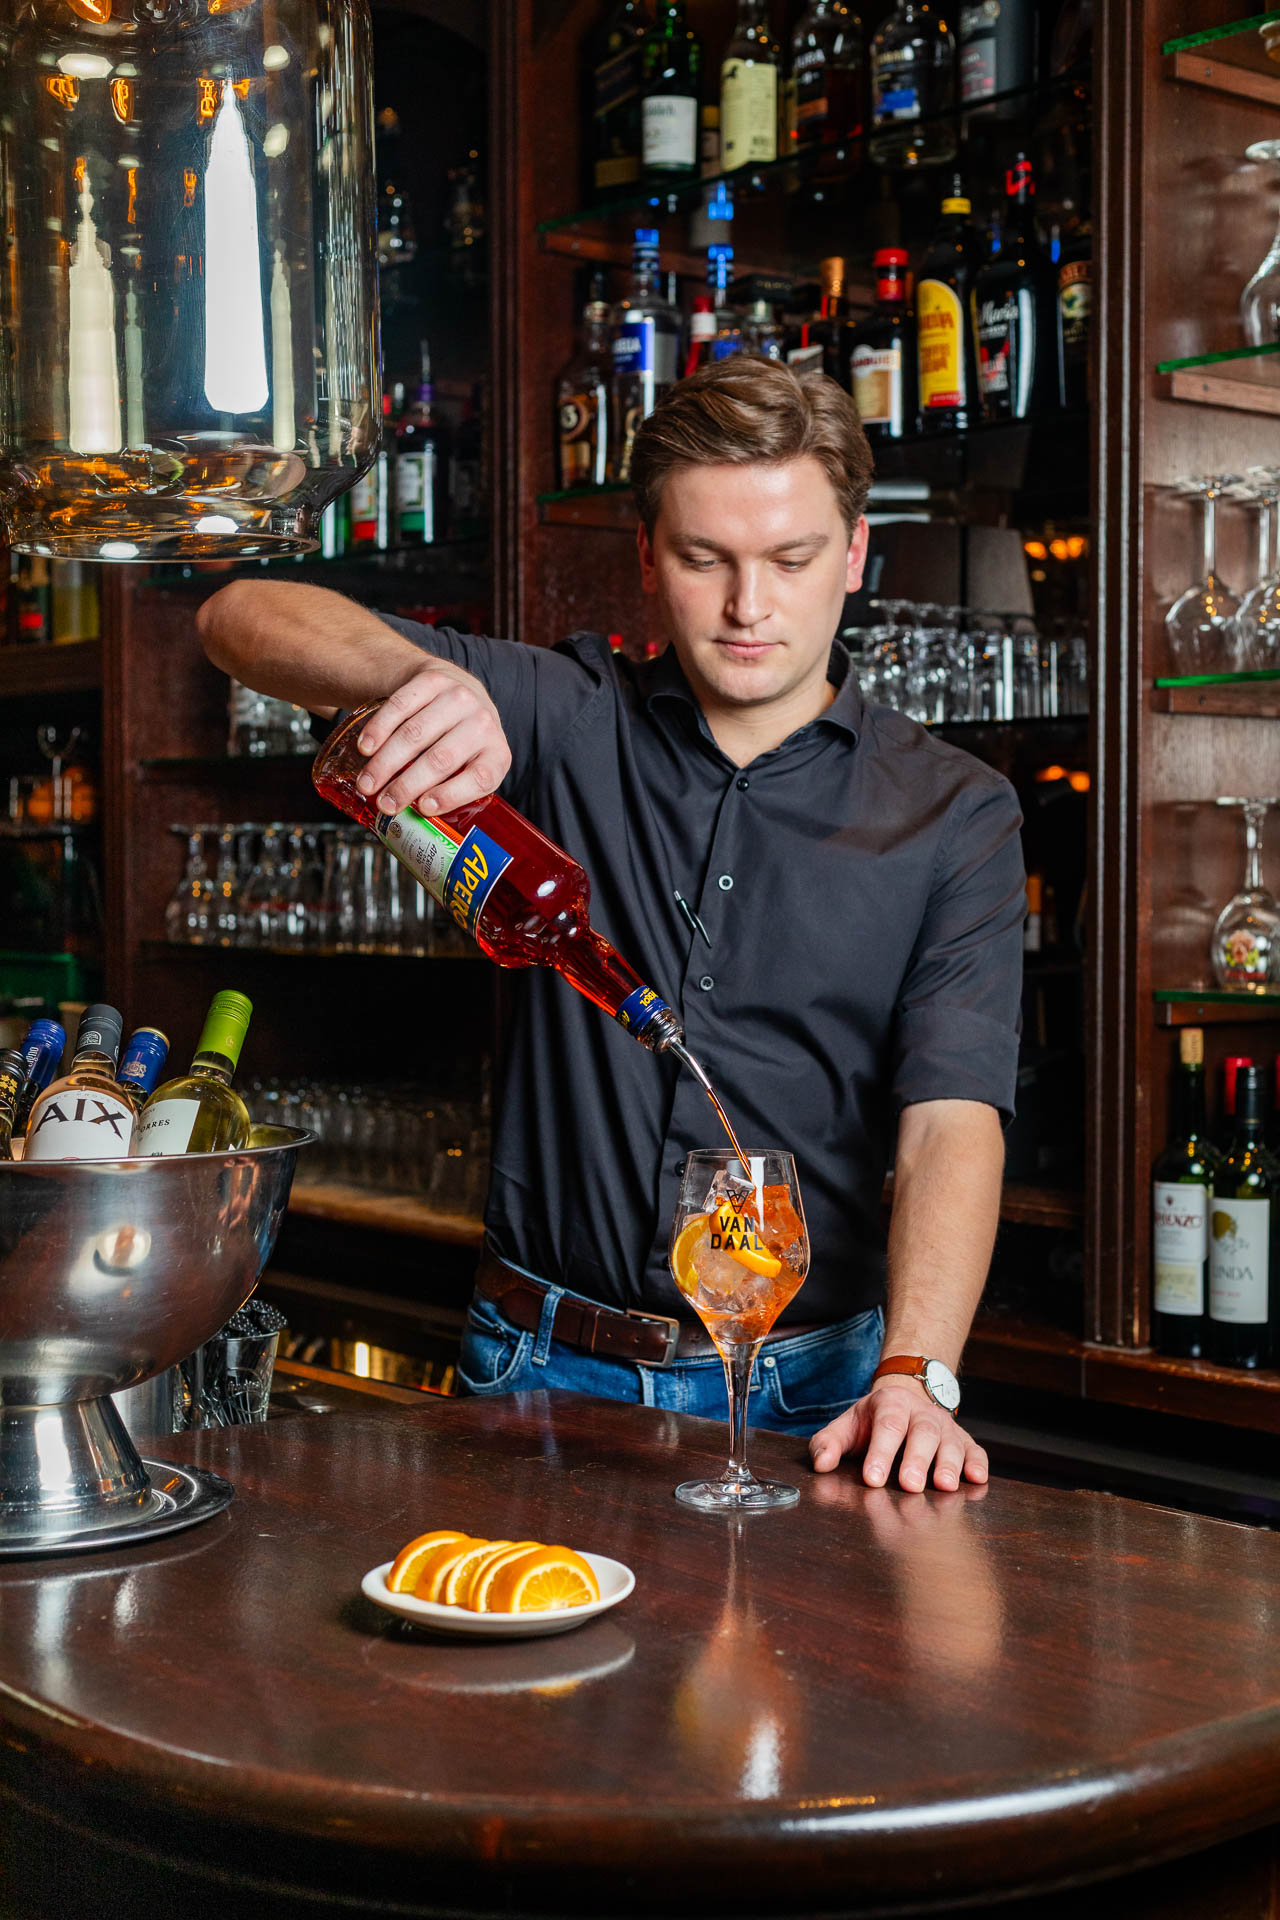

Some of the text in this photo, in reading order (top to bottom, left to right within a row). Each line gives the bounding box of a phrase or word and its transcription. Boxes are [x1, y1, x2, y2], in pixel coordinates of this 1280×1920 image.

[450, 843, 489, 929] APERO
[32, 1098, 127, 1140] AIX
[139, 1118, 171, 1133] ORRES
[719, 1216, 755, 1232] VAN
[711, 1233, 763, 1250] DAAL
